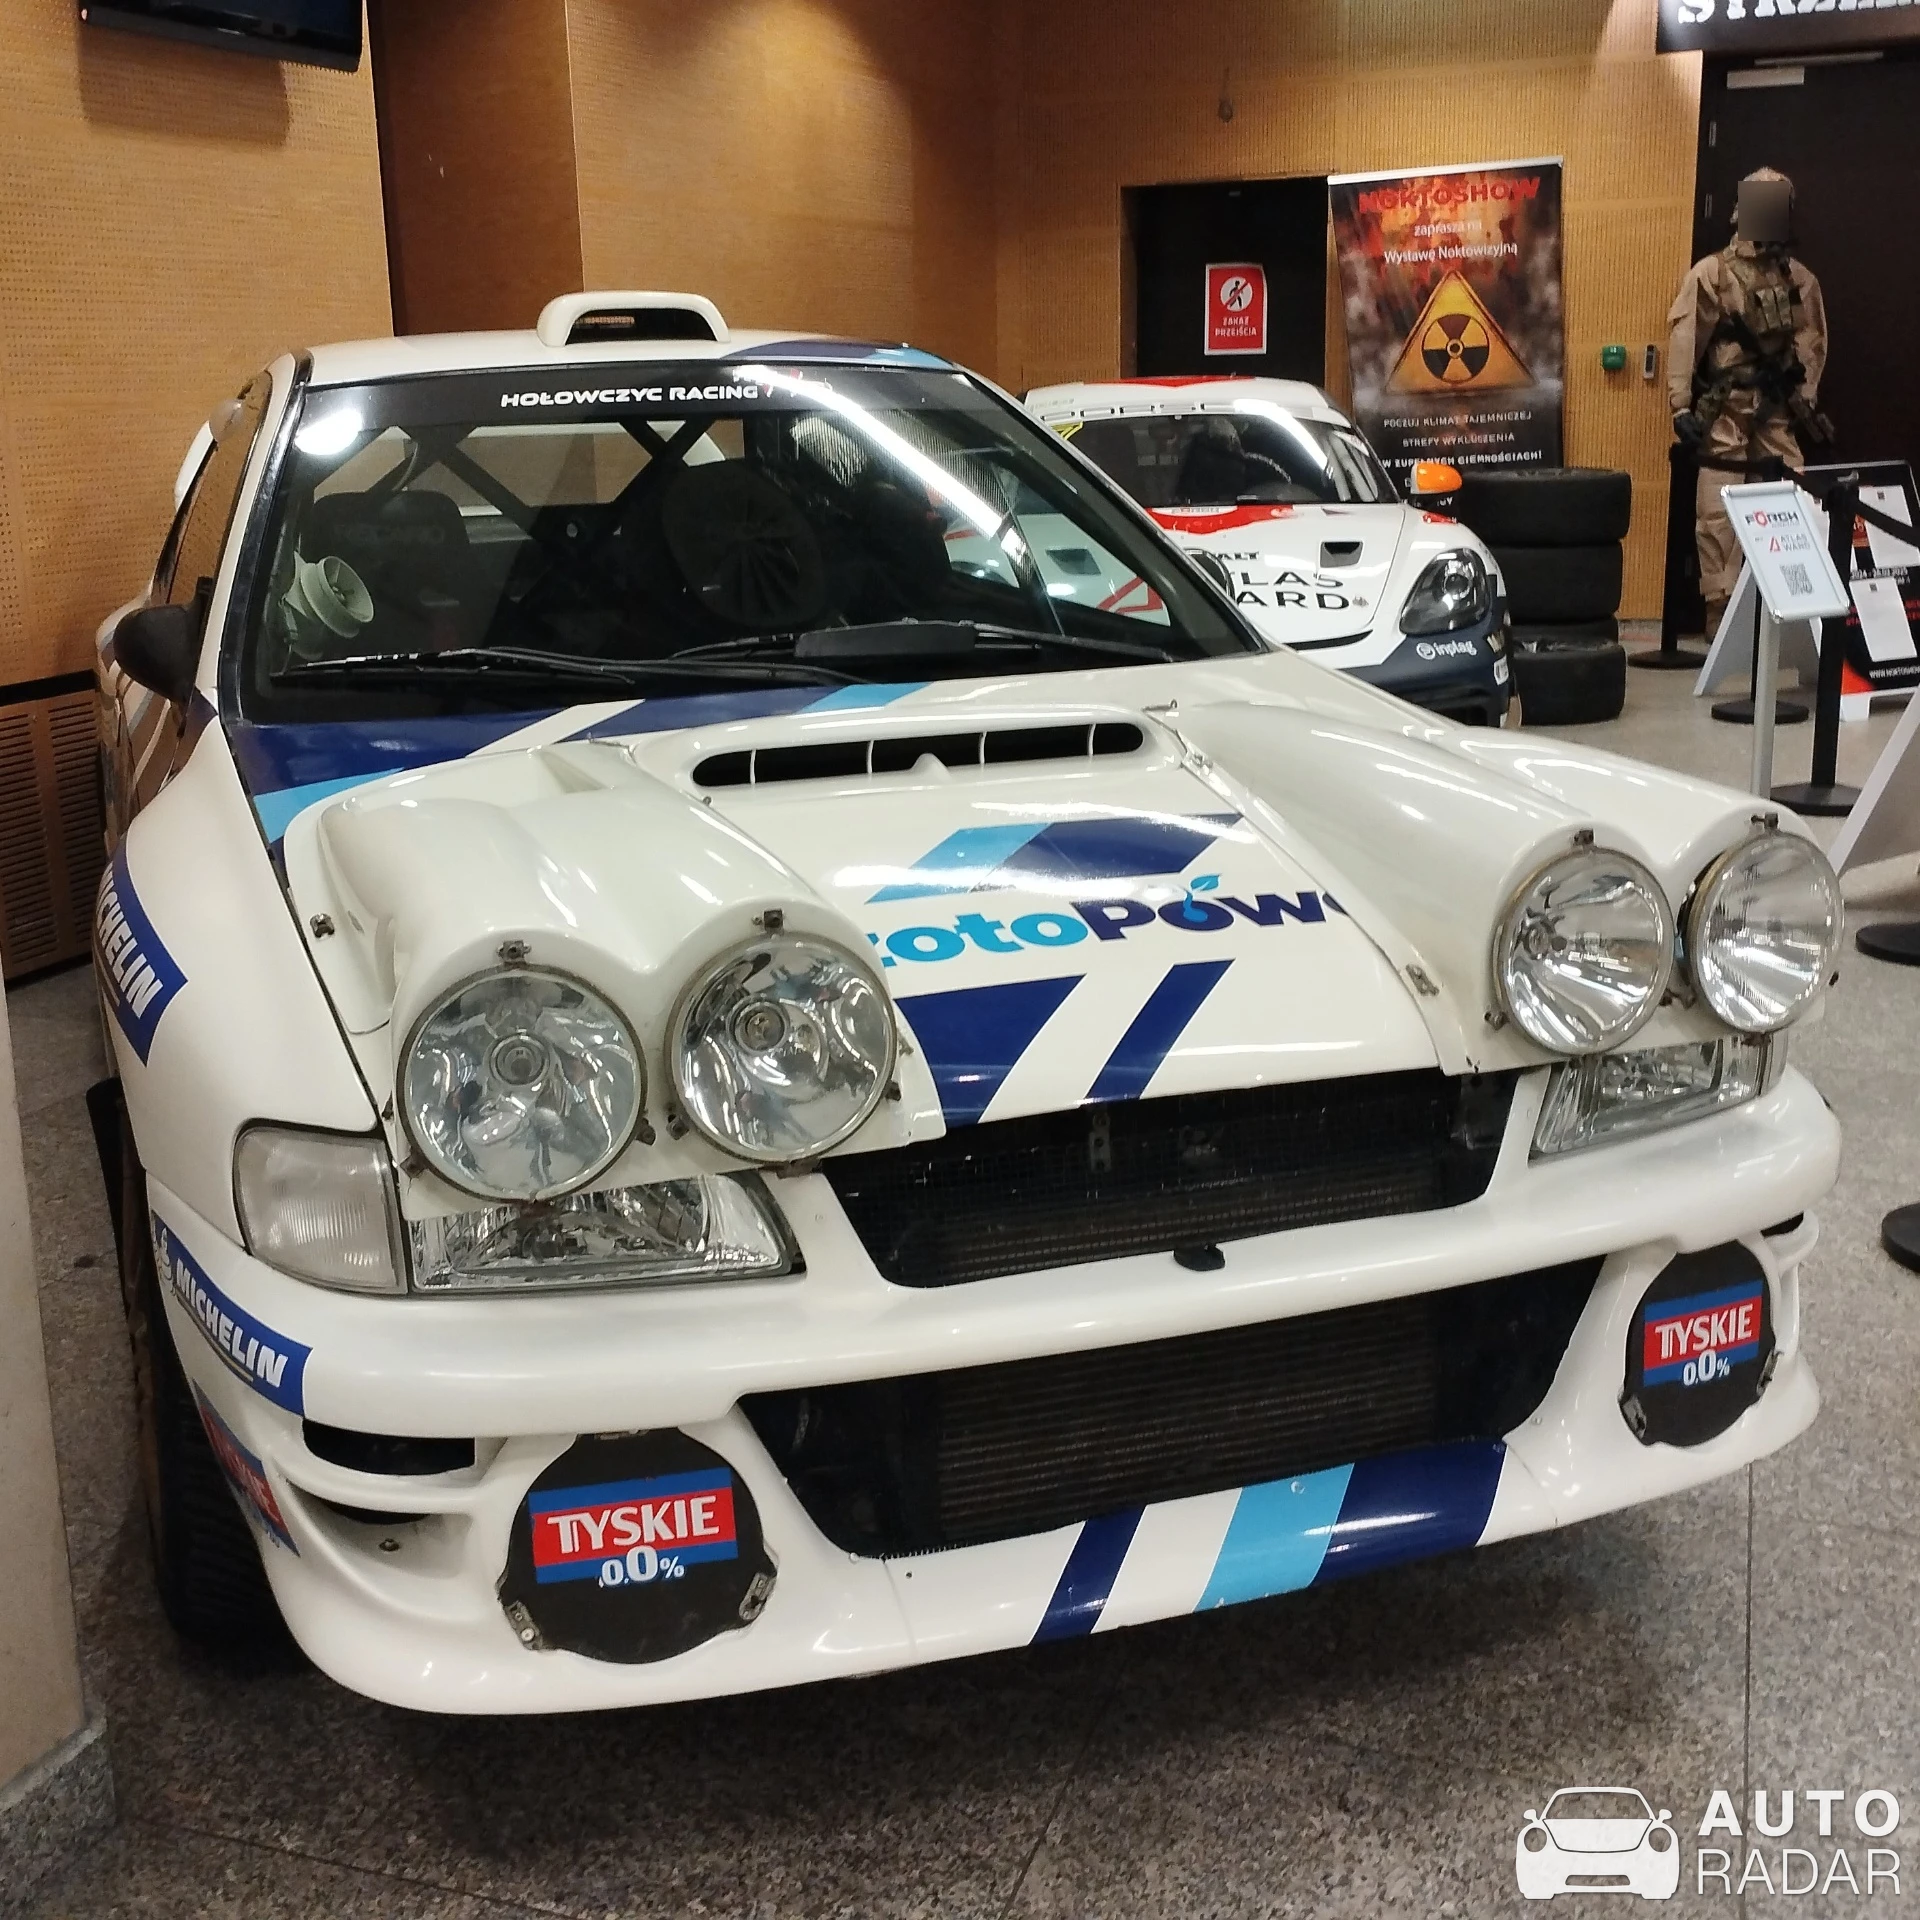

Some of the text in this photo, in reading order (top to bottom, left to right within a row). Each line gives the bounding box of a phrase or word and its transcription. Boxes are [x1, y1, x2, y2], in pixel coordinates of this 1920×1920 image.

[1358, 177, 1540, 213] NOKTOSHOW
[1414, 222, 1464, 238] zaprasza
[1384, 242, 1518, 265] Wystawę Noktowizyjną
[1223, 316, 1250, 326] ZAKAZ
[500, 385, 758, 408] HOŁOWCZYC RACING
[1232, 571, 1344, 588] LAS
[1237, 591, 1350, 609] ARD
[175, 1257, 289, 1387] MICHELIN
[1655, 1304, 1753, 1359] TYSKIE
[547, 1495, 720, 1554] TYSKIE
